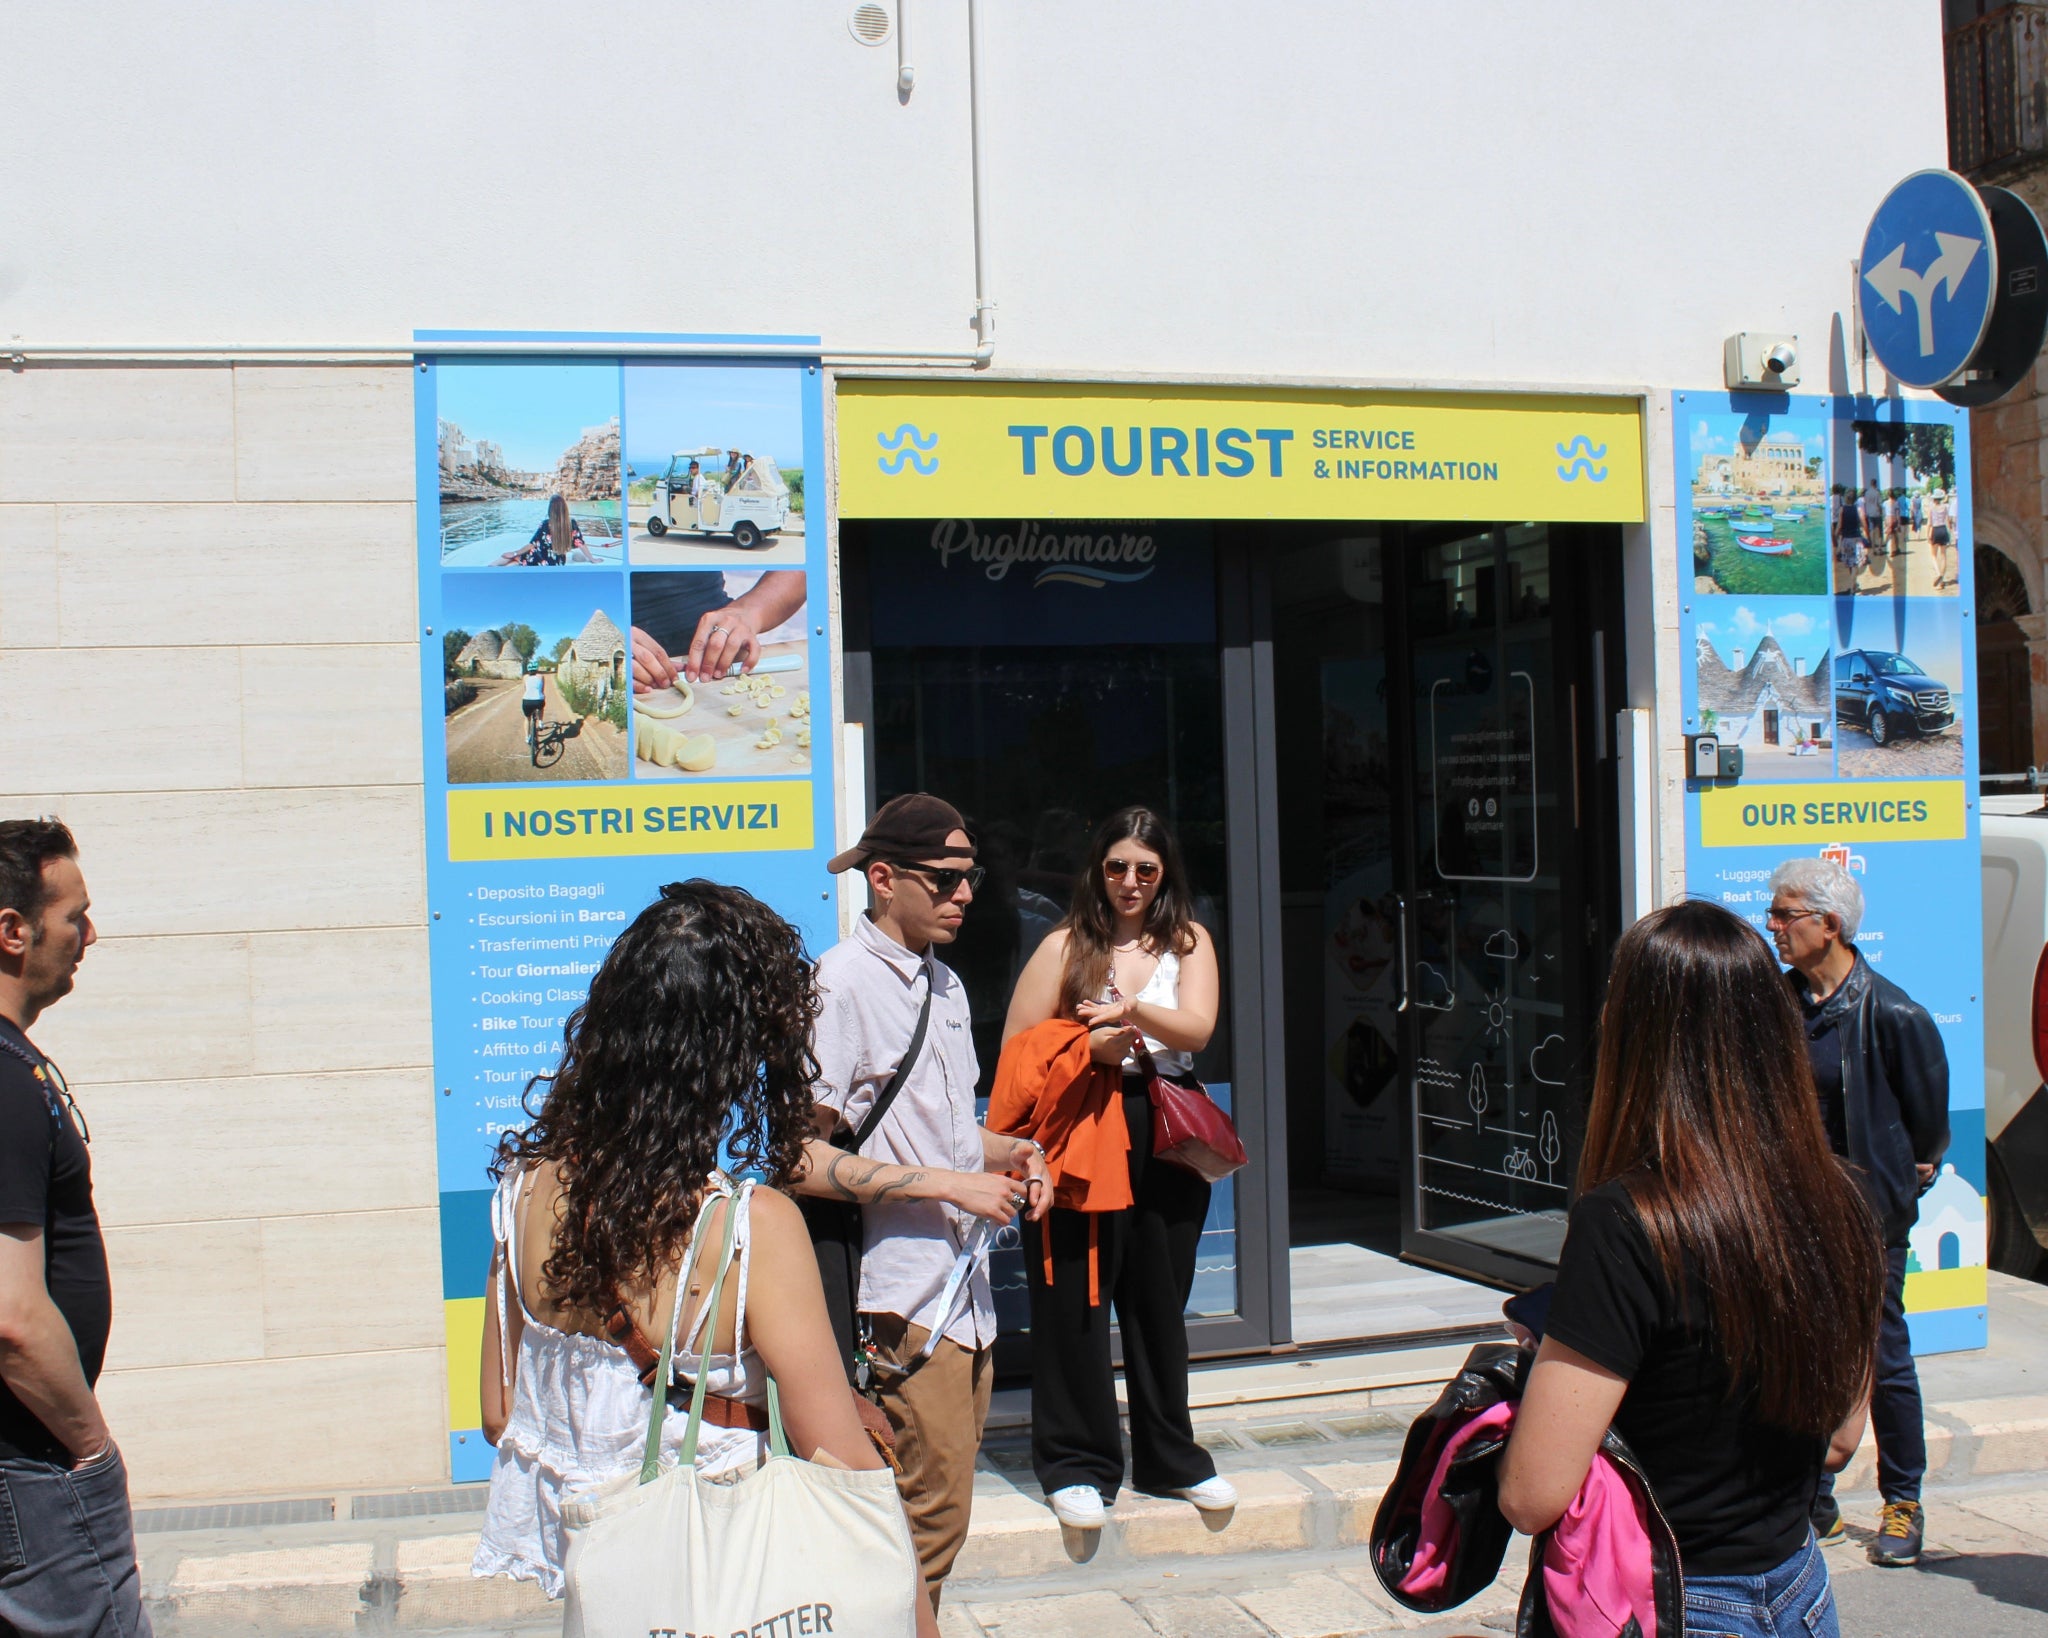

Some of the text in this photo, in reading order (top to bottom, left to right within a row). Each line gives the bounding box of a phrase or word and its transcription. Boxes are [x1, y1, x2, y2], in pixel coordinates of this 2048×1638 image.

[1312, 429, 1415, 450] SERVICE
[1007, 425, 1295, 478] TOURIST
[1313, 459, 1498, 481] & INFORMATION
[931, 519, 1157, 581] Pugliamare
[484, 803, 778, 838] I NOSTRI SERVIZI
[1742, 799, 1928, 827] OUR SERVICES
[1722, 869, 1772, 883] Luggage
[477, 882, 605, 902] Deposito Bagagli
[1722, 889, 1775, 903] Boat Tou
[478, 909, 626, 927] Escursioni in Barca
[478, 936, 579, 952] Trasferimenti
[1854, 931, 1885, 942] ours
[1863, 950, 1884, 964] hef
[479, 960, 601, 979] Tour Giornalieri
[481, 988, 587, 1006] Cooking Class
[481, 1016, 518, 1031] Bike
[520, 1015, 554, 1029] Tour
[1933, 1011, 1963, 1024] Tours
[482, 1042, 530, 1057] Affitto
[533, 1040, 547, 1055] di
[483, 1069, 517, 1083] Tour
[520, 1067, 535, 1081] in
[485, 1118, 527, 1135] Food
